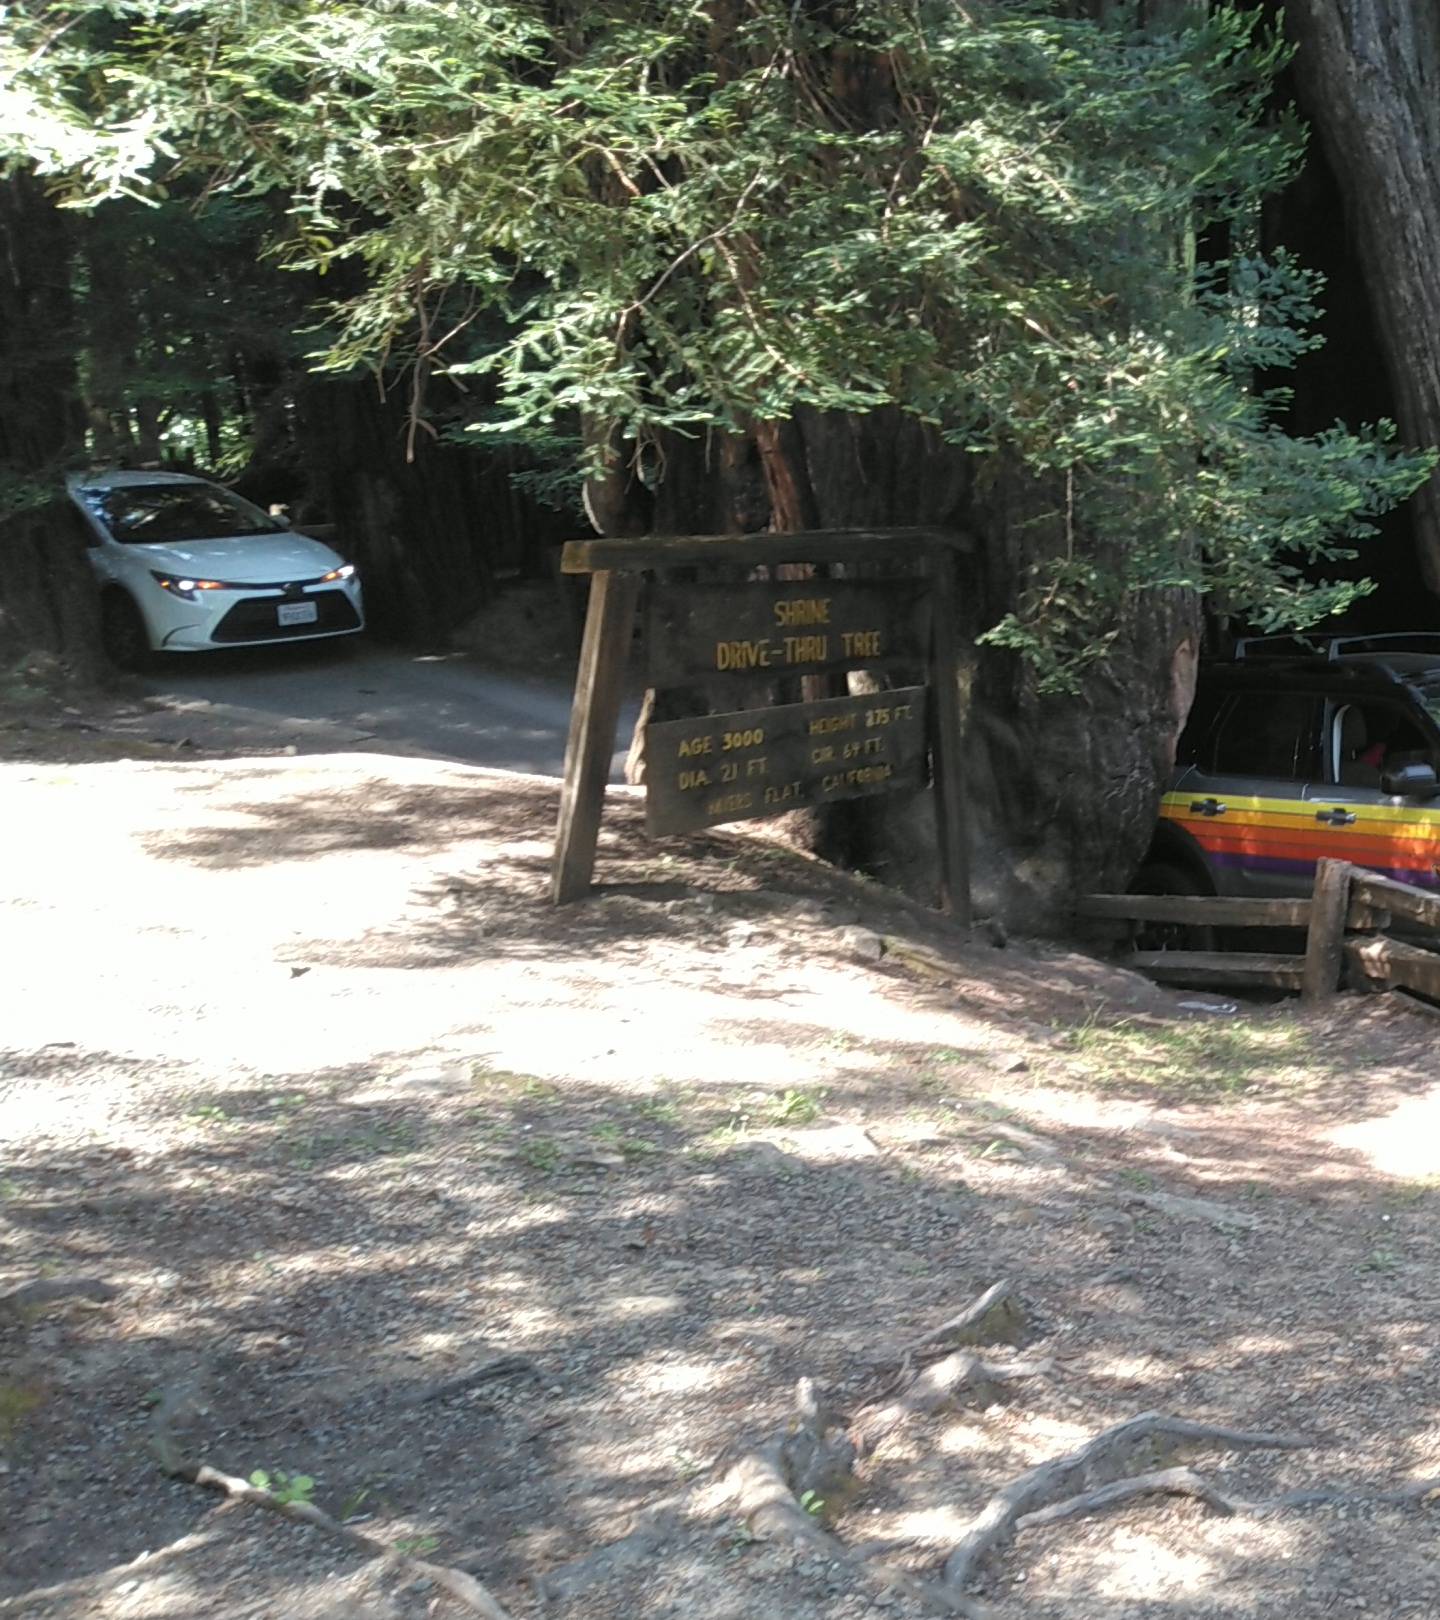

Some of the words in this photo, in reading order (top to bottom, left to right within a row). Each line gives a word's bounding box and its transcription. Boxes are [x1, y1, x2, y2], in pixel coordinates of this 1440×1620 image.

[774, 599, 831, 627] SHRINE
[717, 635, 827, 670] DRIVE-THRU
[841, 631, 881, 657] TREE
[678, 736, 713, 758] AGE
[722, 728, 765, 751] 3000
